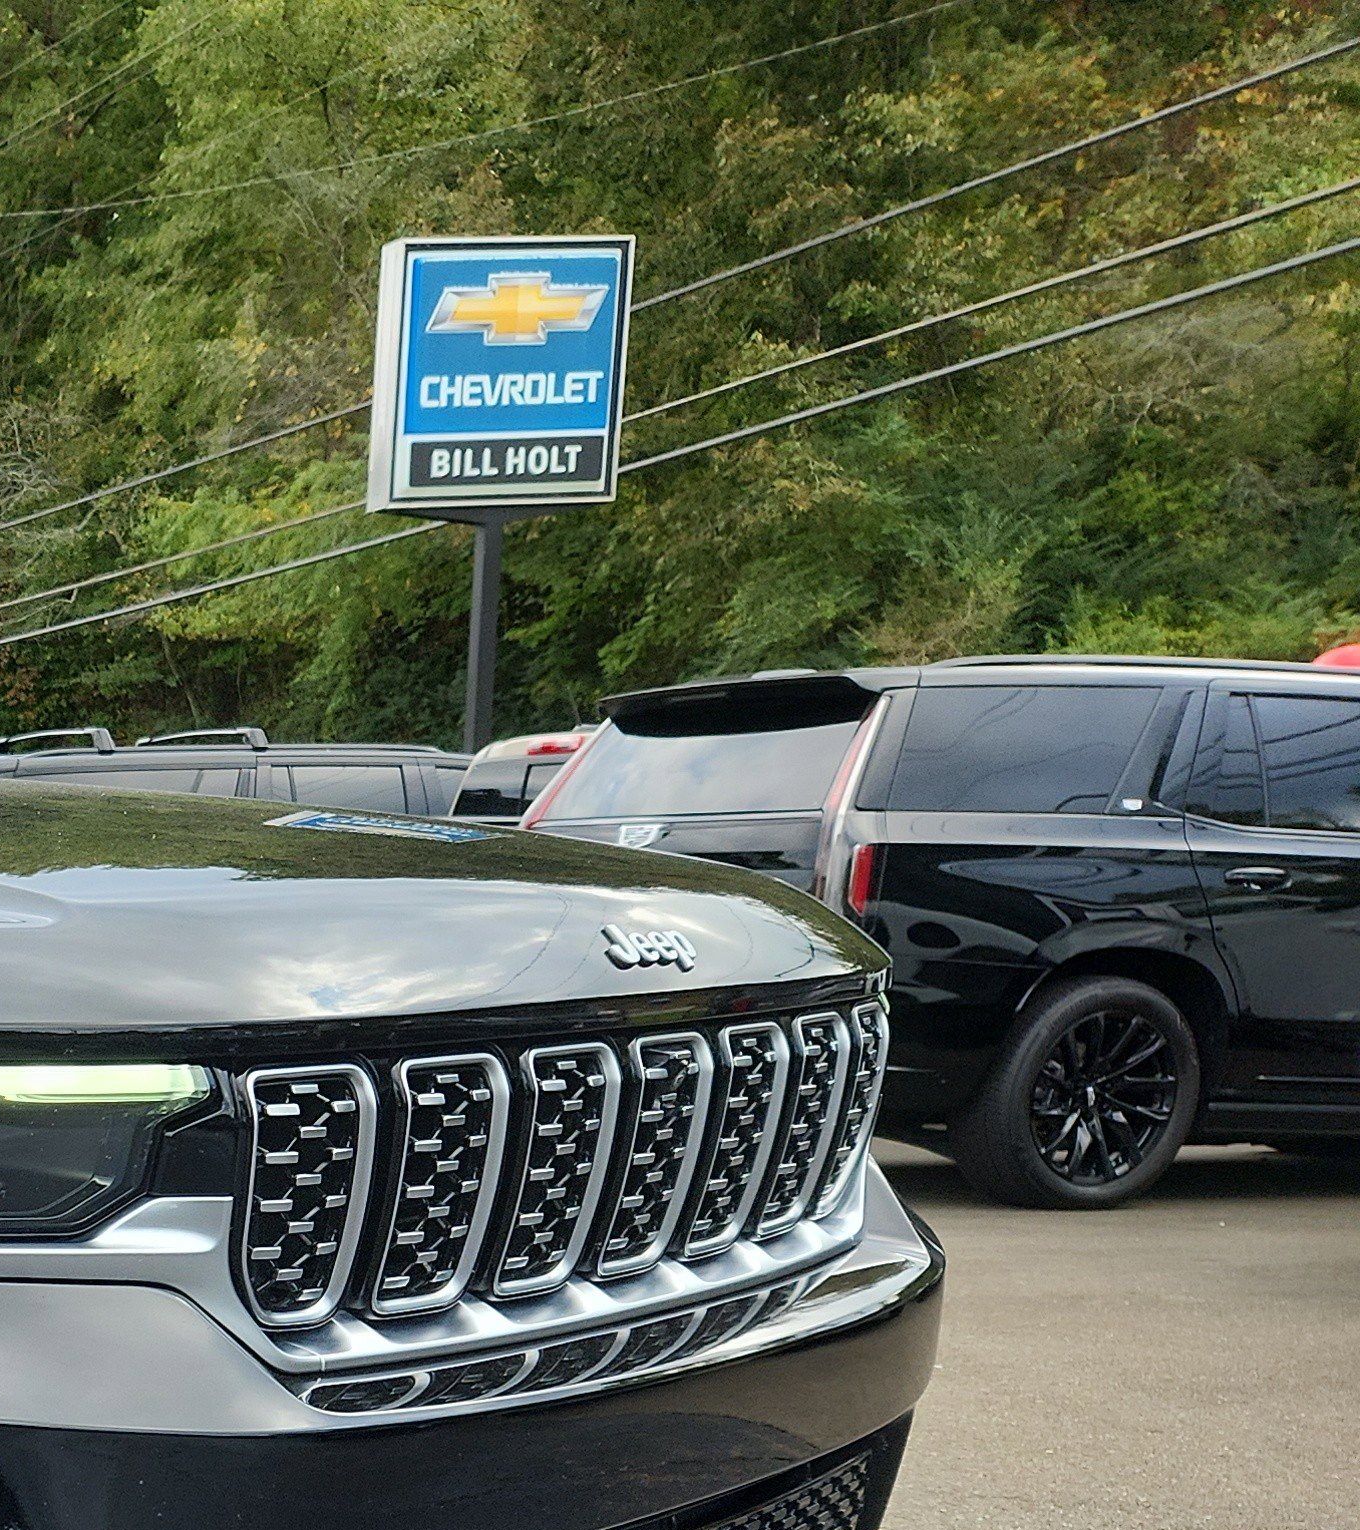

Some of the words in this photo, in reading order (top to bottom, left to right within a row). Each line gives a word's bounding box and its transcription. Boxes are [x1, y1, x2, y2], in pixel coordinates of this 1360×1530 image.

[420, 371, 604, 408] CHEVROLET
[430, 448, 499, 478] BILL
[505, 444, 582, 475] HOLT
[601, 924, 697, 972] Jeep
